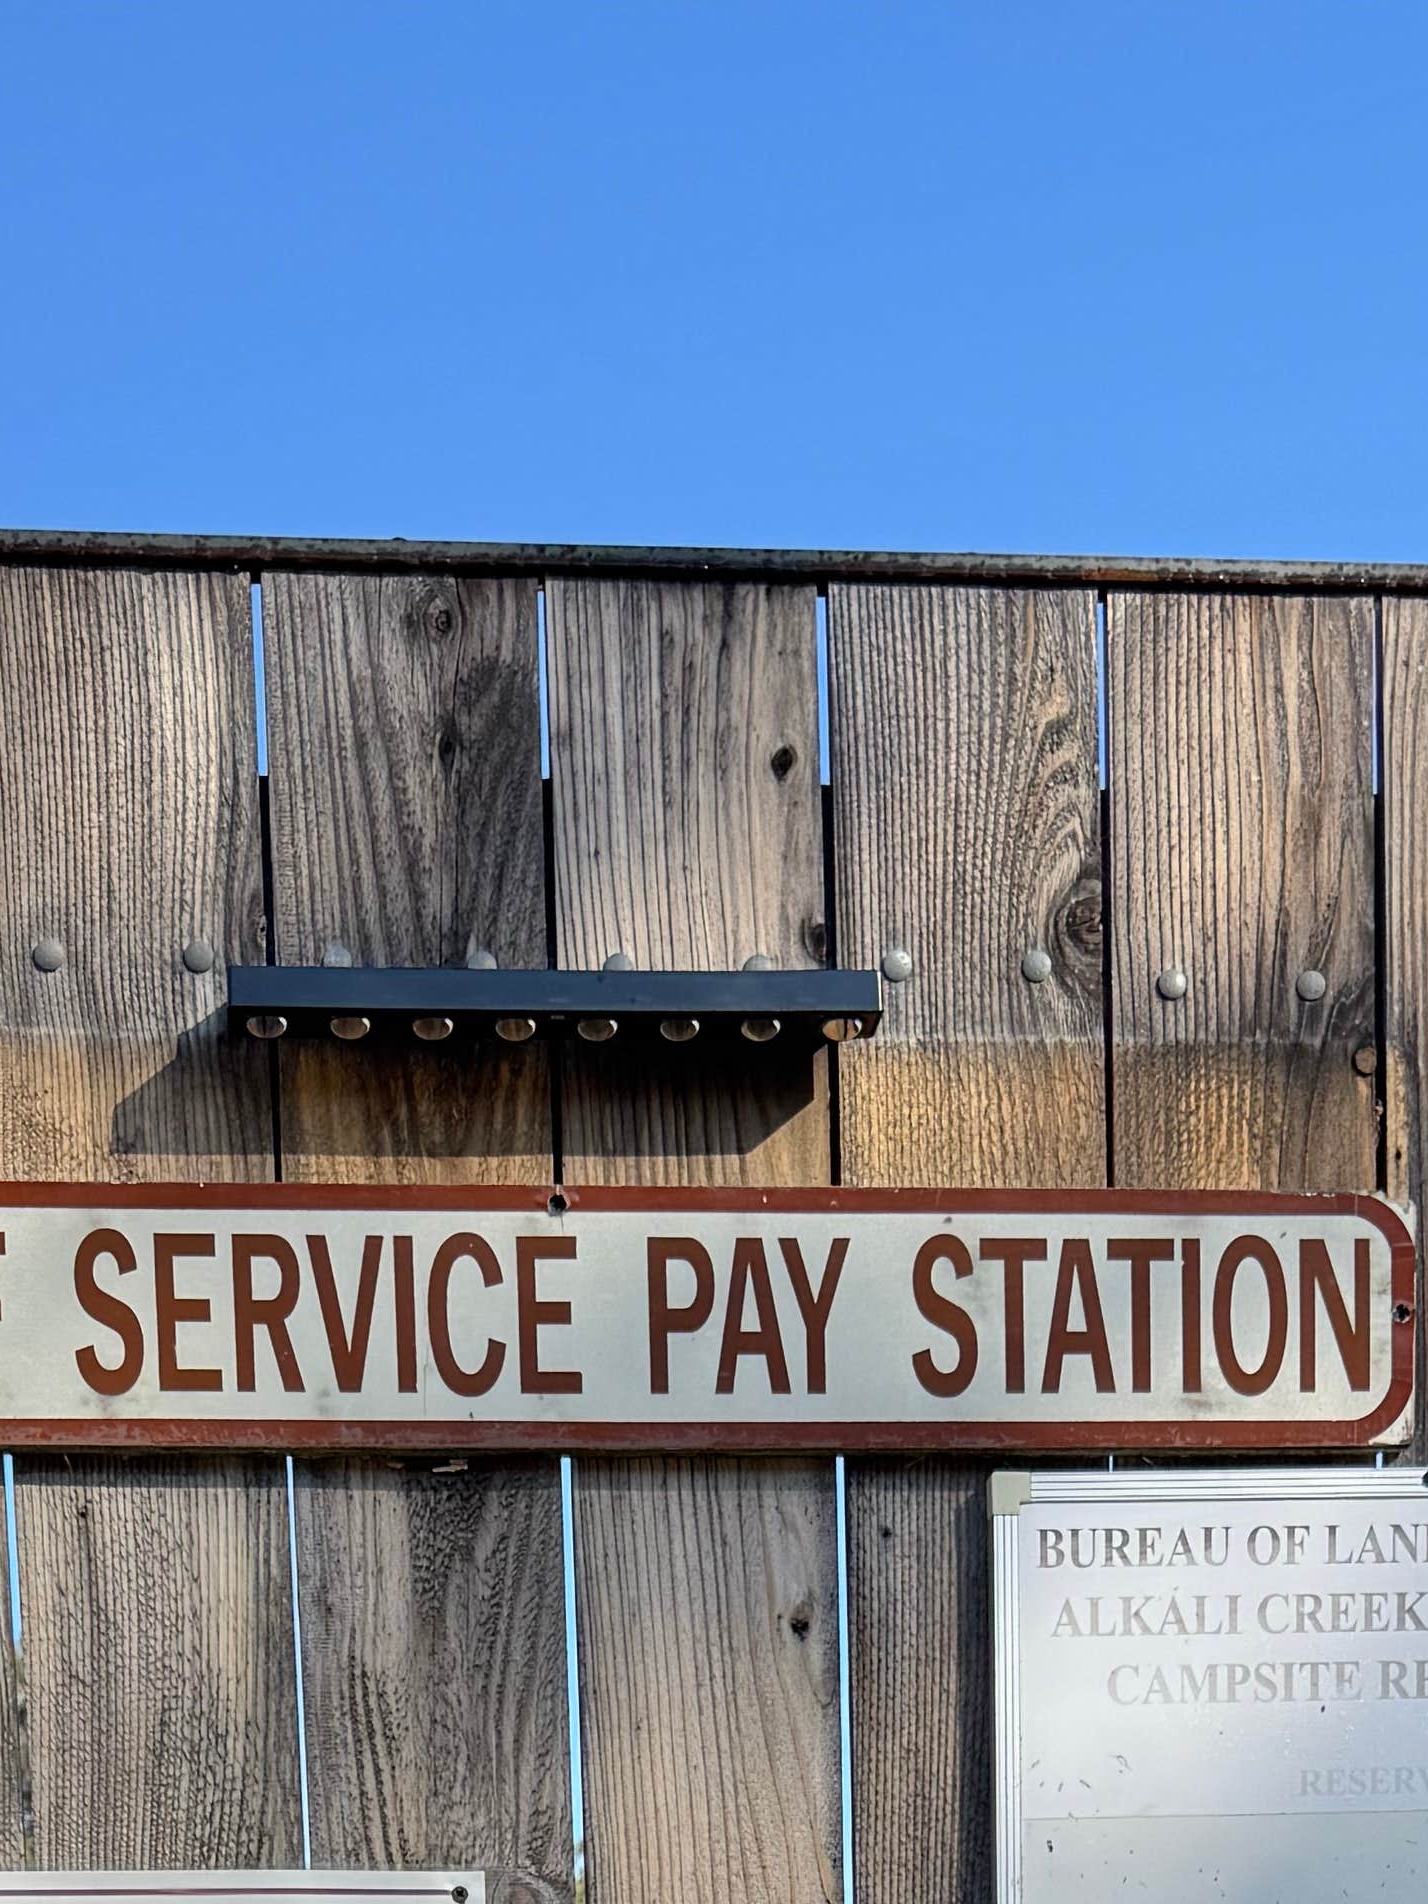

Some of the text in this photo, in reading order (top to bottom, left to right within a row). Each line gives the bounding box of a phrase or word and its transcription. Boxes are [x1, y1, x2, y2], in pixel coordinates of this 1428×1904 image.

[73, 1228, 583, 1397] SERVICE
[647, 1236, 851, 1395] PAY
[911, 1233, 1371, 1398] STATION
[1036, 1526, 1230, 1569] BUREAU
[1246, 1525, 1309, 1567] OF
[1050, 1593, 1241, 1638] ALKALI
[1257, 1591, 1428, 1634] CREEK
[1106, 1660, 1364, 1706] CAMPSITE
